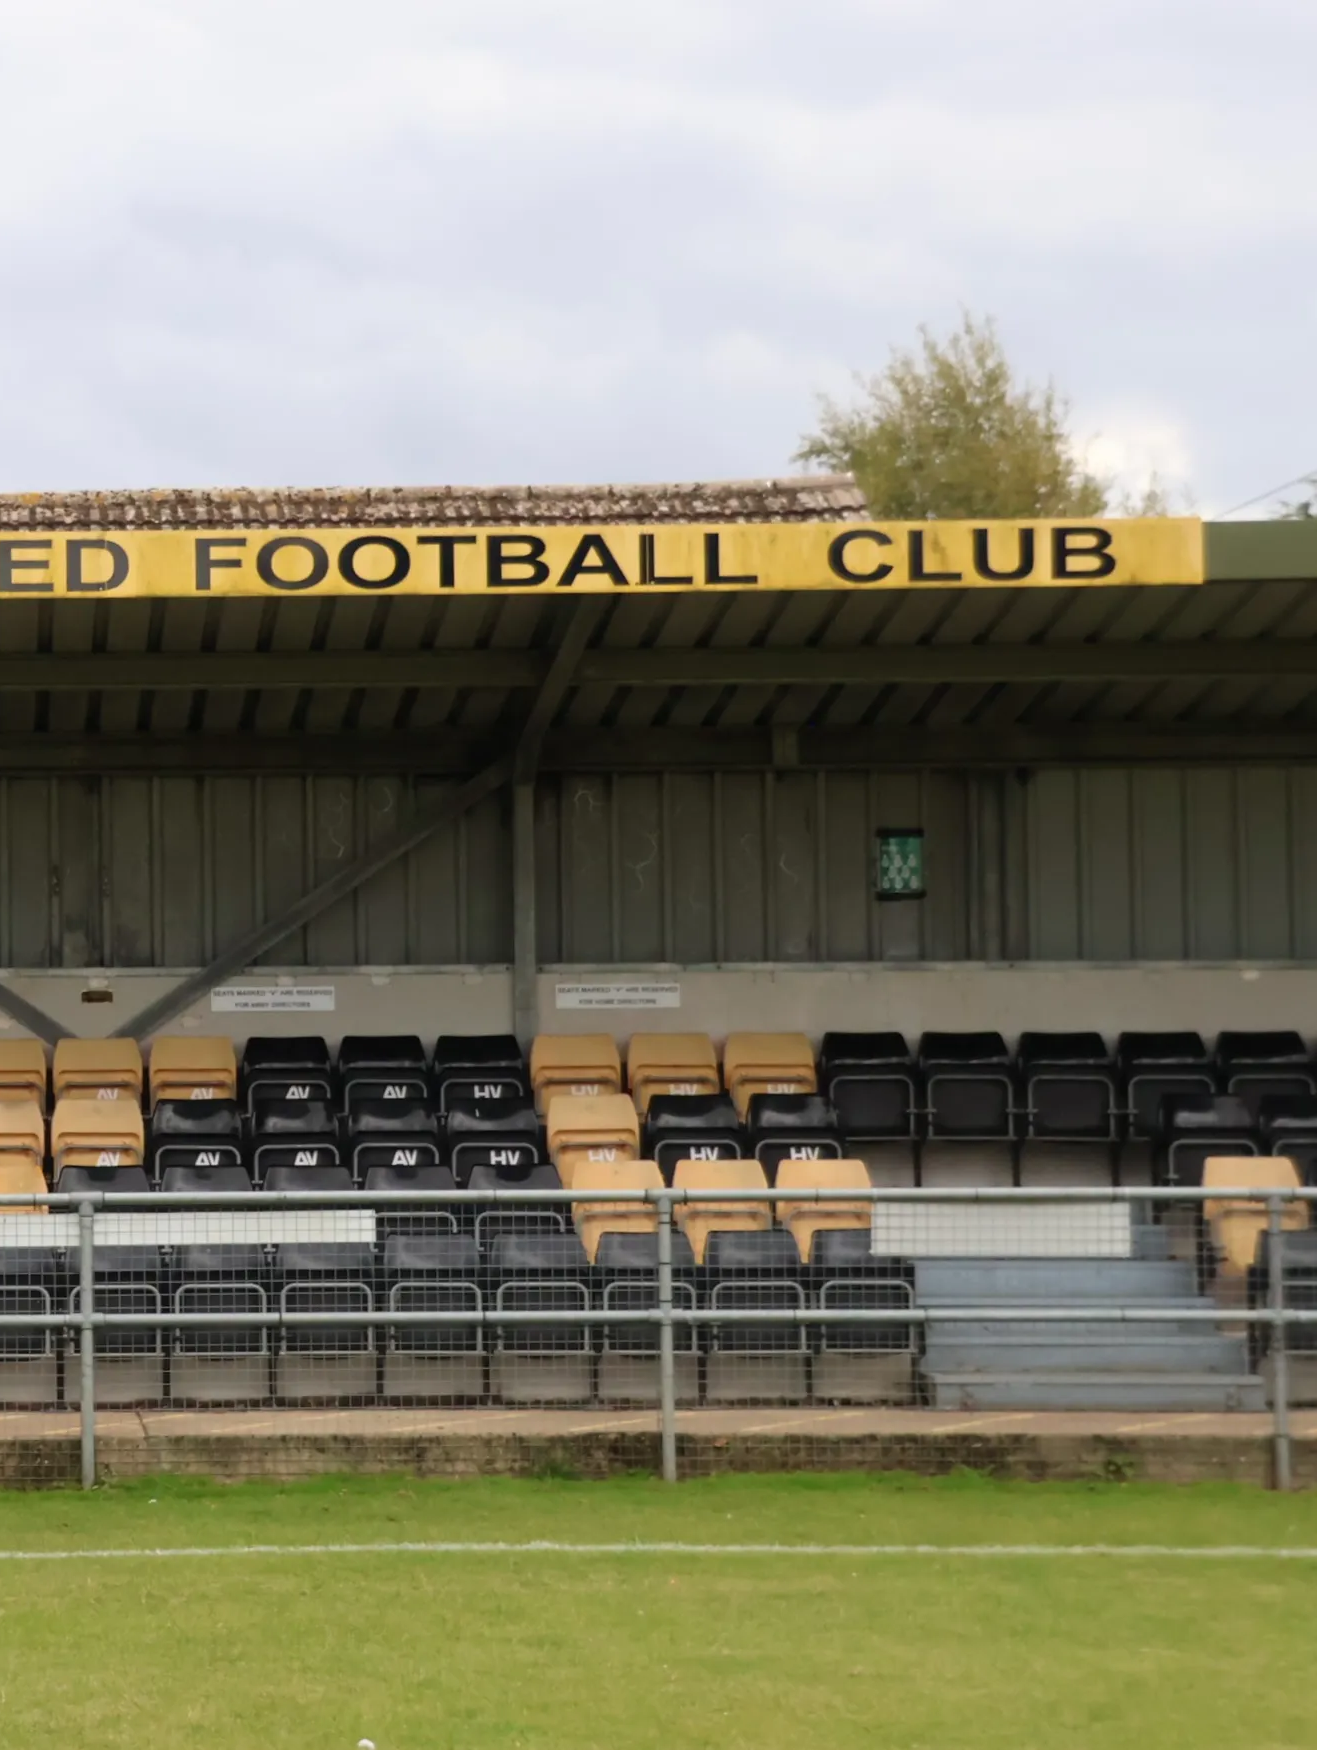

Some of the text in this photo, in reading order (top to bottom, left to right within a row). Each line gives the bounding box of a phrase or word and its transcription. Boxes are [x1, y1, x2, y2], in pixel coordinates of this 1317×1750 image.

[194, 532, 758, 591] FOOTBALL
[827, 527, 1117, 583] CLUB
[97, 1087, 118, 1100] AV
[190, 1087, 213, 1100] AV
[286, 1085, 310, 1099] AV
[383, 1085, 407, 1099] AV
[474, 1085, 502, 1099] HV
[96, 1151, 120, 1167] AV
[195, 1151, 220, 1166] AV
[294, 1150, 318, 1166] AV
[392, 1150, 417, 1166] AV
[490, 1150, 520, 1166] HV
[588, 1148, 616, 1162] HV
[690, 1146, 719, 1160] HV
[790, 1146, 819, 1161] HV
